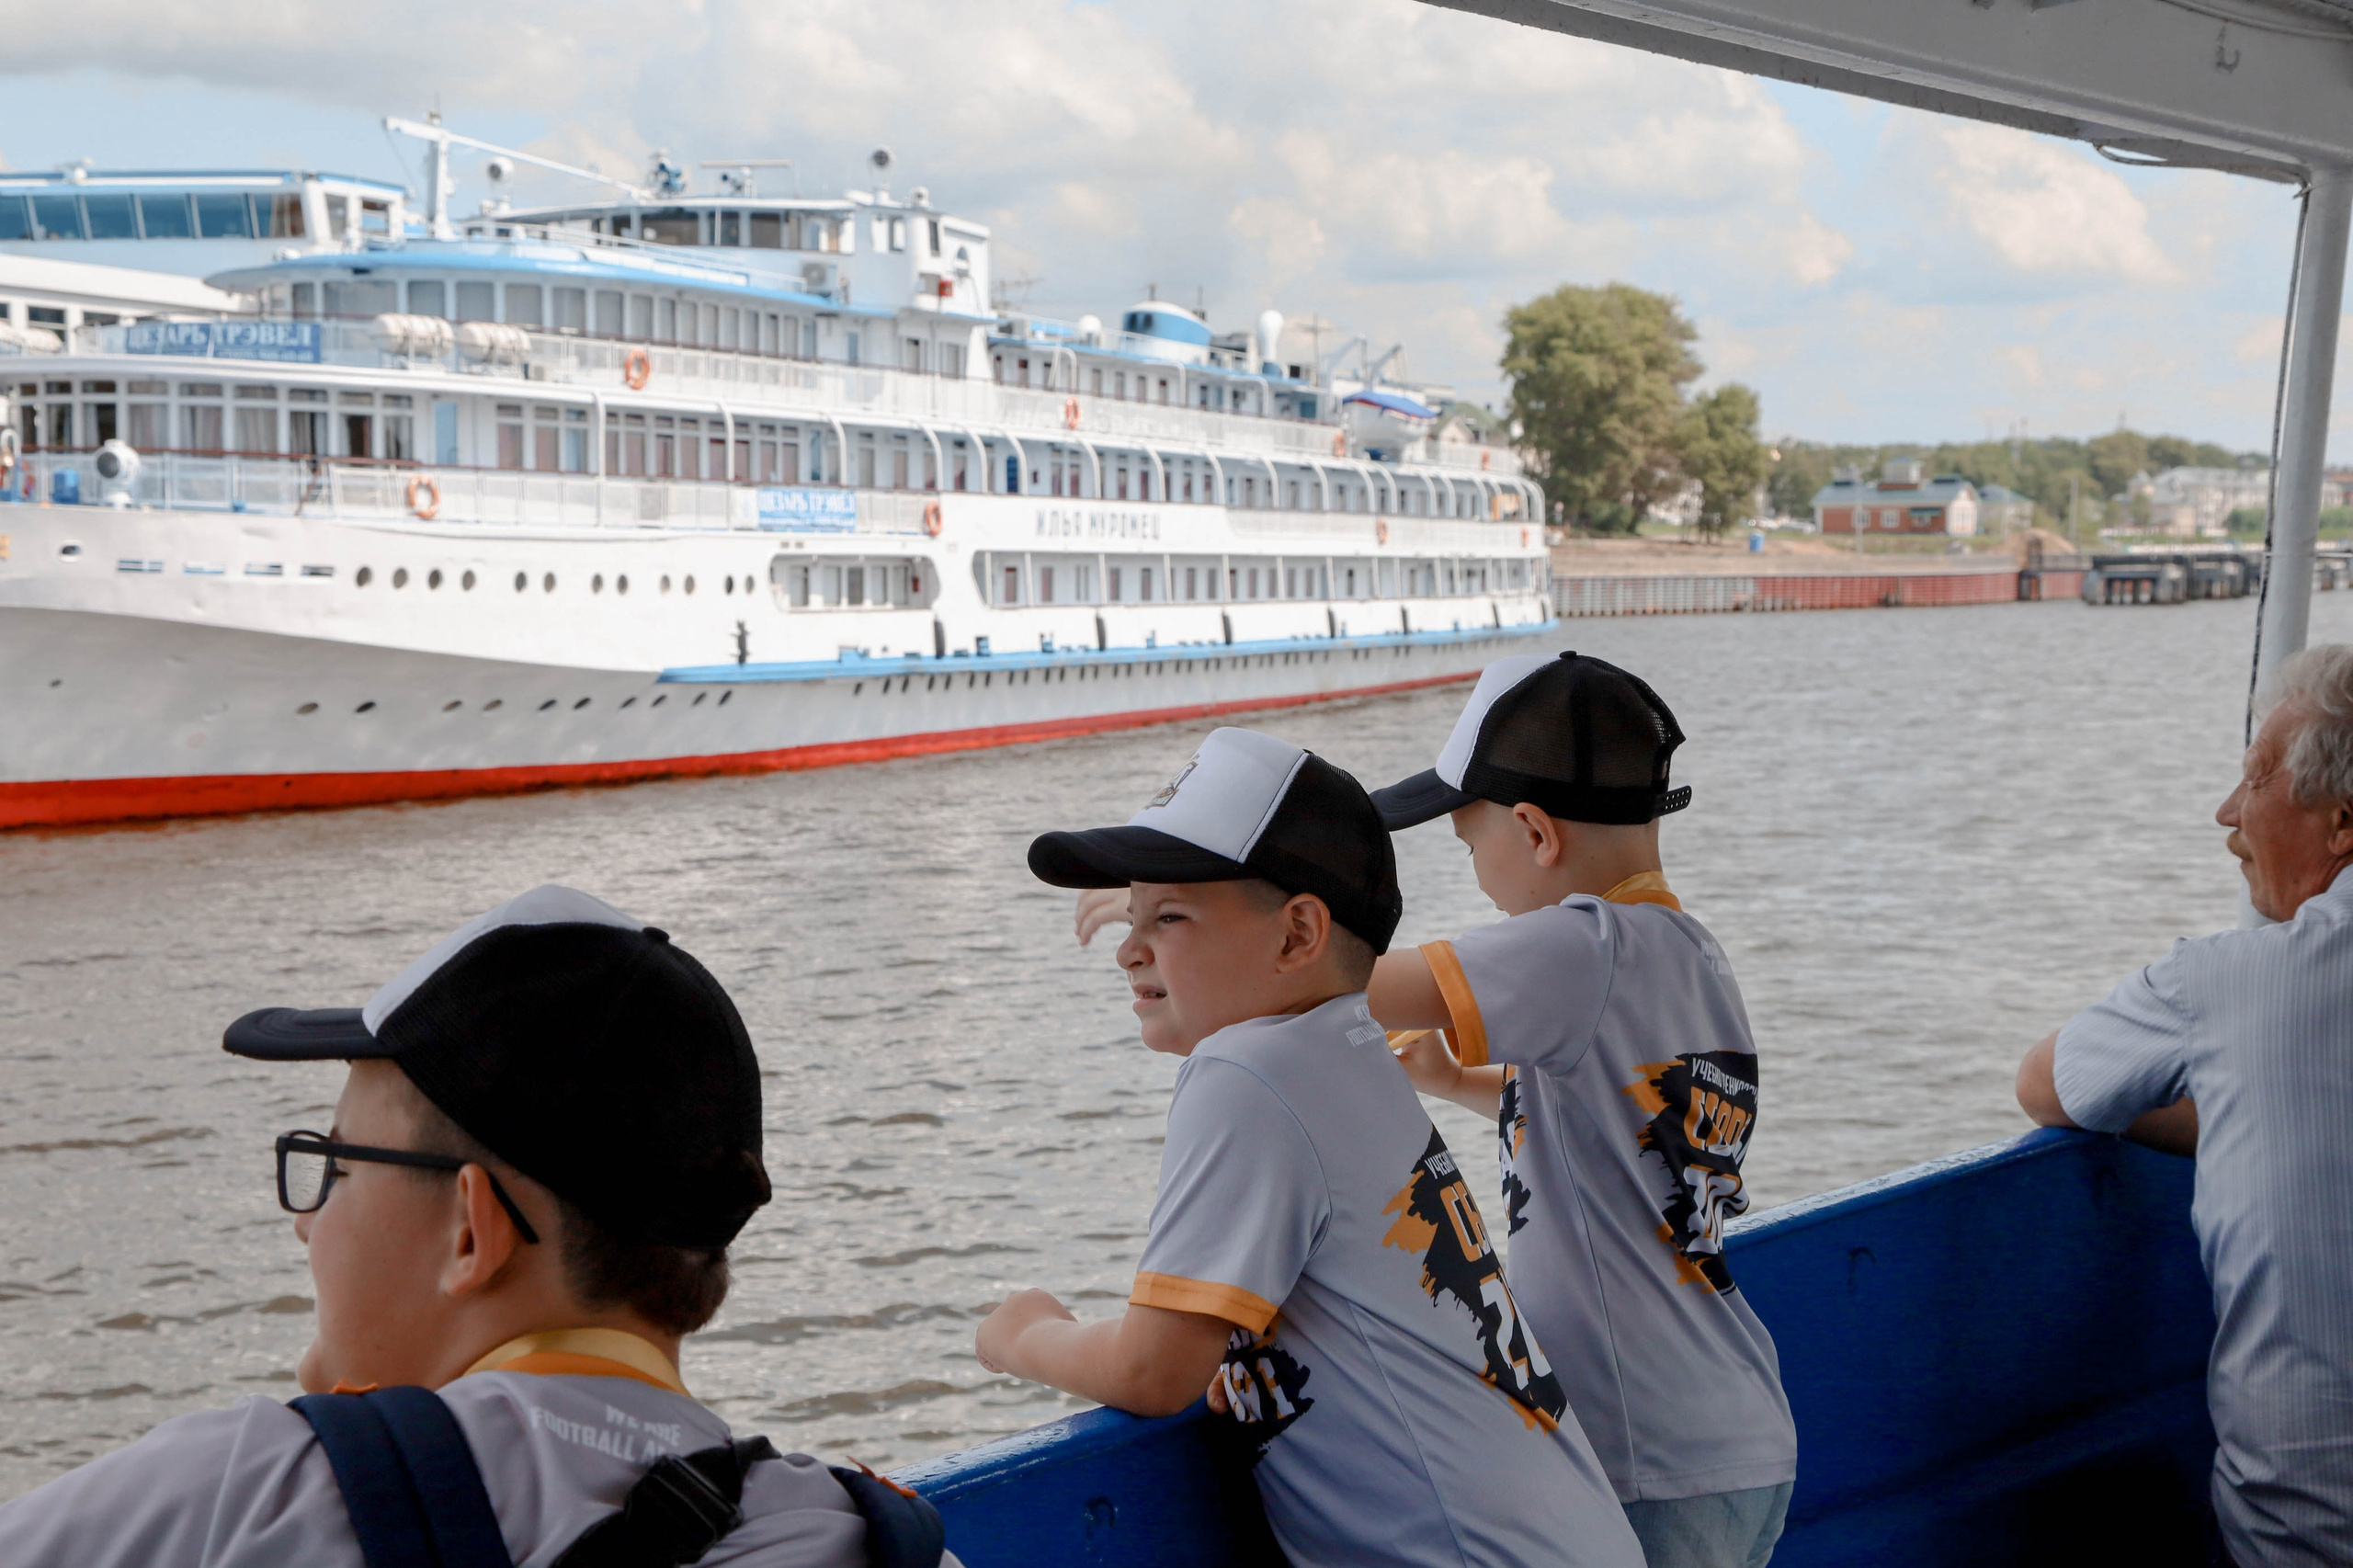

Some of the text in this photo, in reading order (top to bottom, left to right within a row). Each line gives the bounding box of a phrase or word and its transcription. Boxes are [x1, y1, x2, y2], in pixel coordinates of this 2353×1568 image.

[1035, 508, 1161, 540] ИЛЬЯ МУРОМЕЦ
[529, 1405, 635, 1463] FOOTBALL
